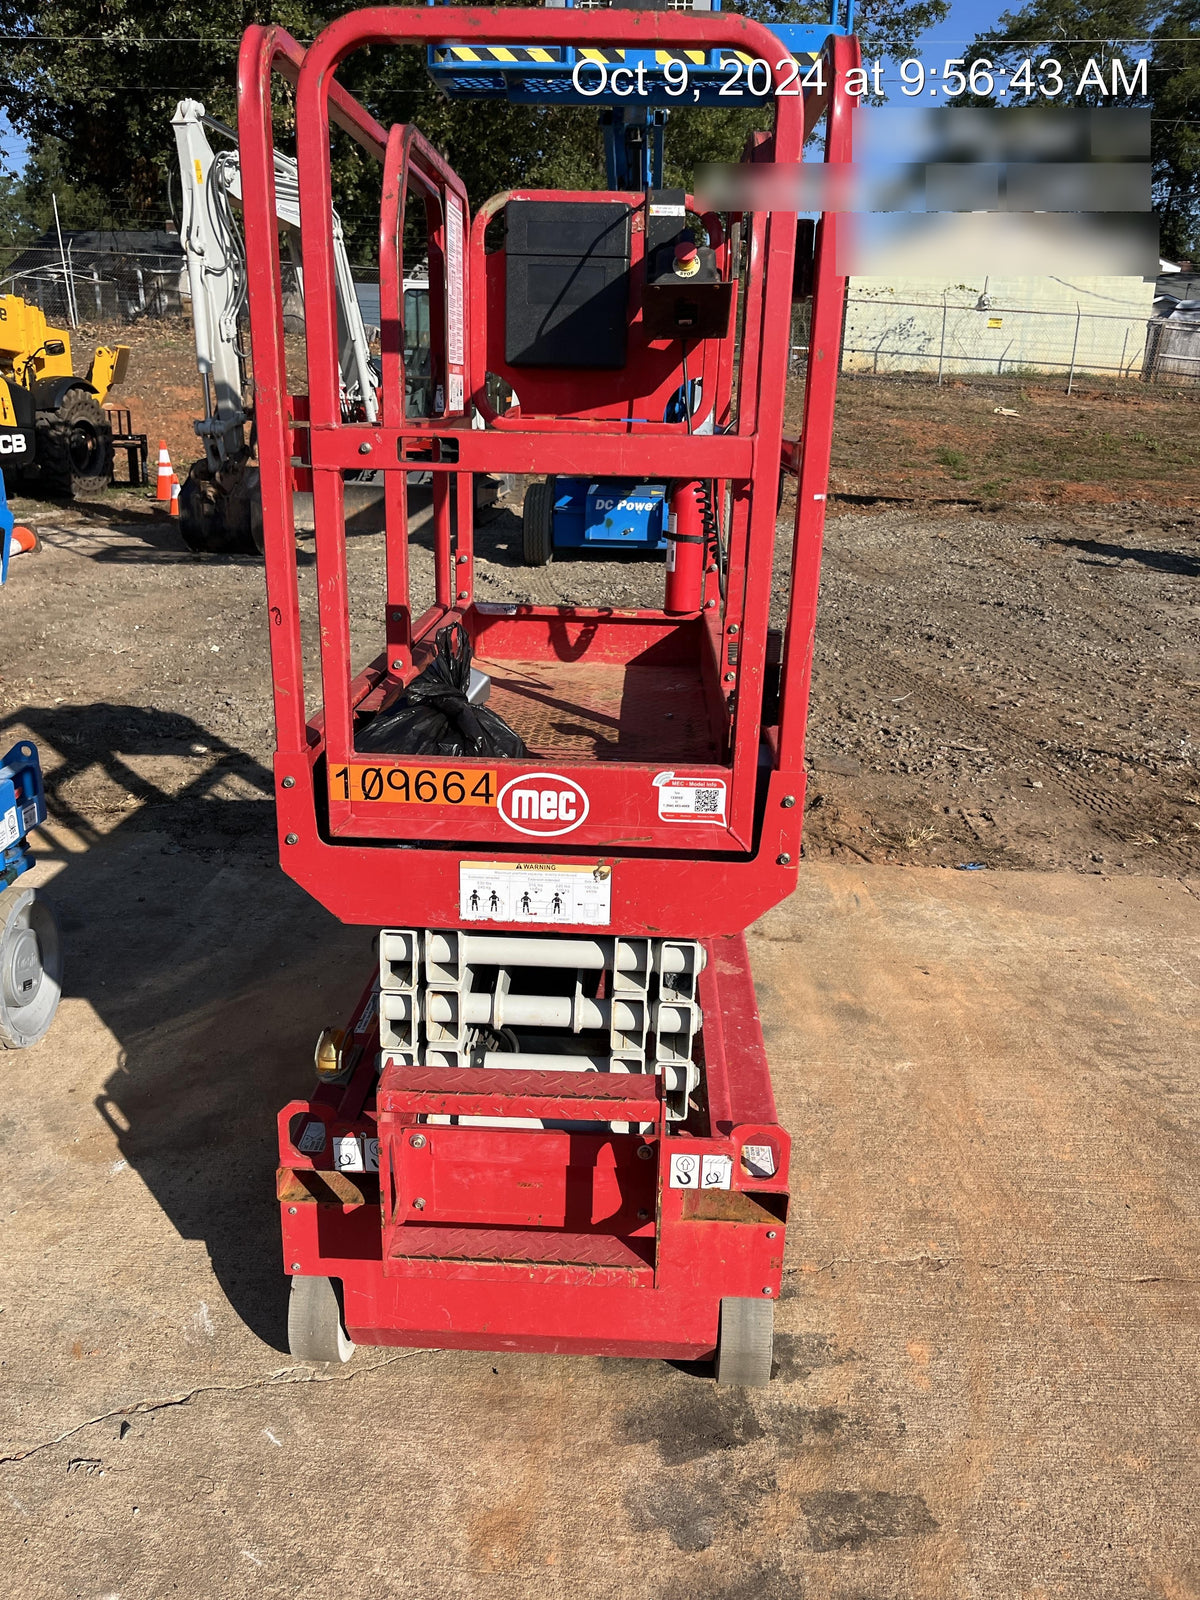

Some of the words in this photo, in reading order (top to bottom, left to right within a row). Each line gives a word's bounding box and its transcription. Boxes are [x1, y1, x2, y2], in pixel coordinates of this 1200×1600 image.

[0, 434, 27, 454] CB
[595, 499, 614, 510] DC
[617, 499, 659, 511] Power
[334, 766, 495, 805] 109664
[523, 863, 557, 871] WARNING
